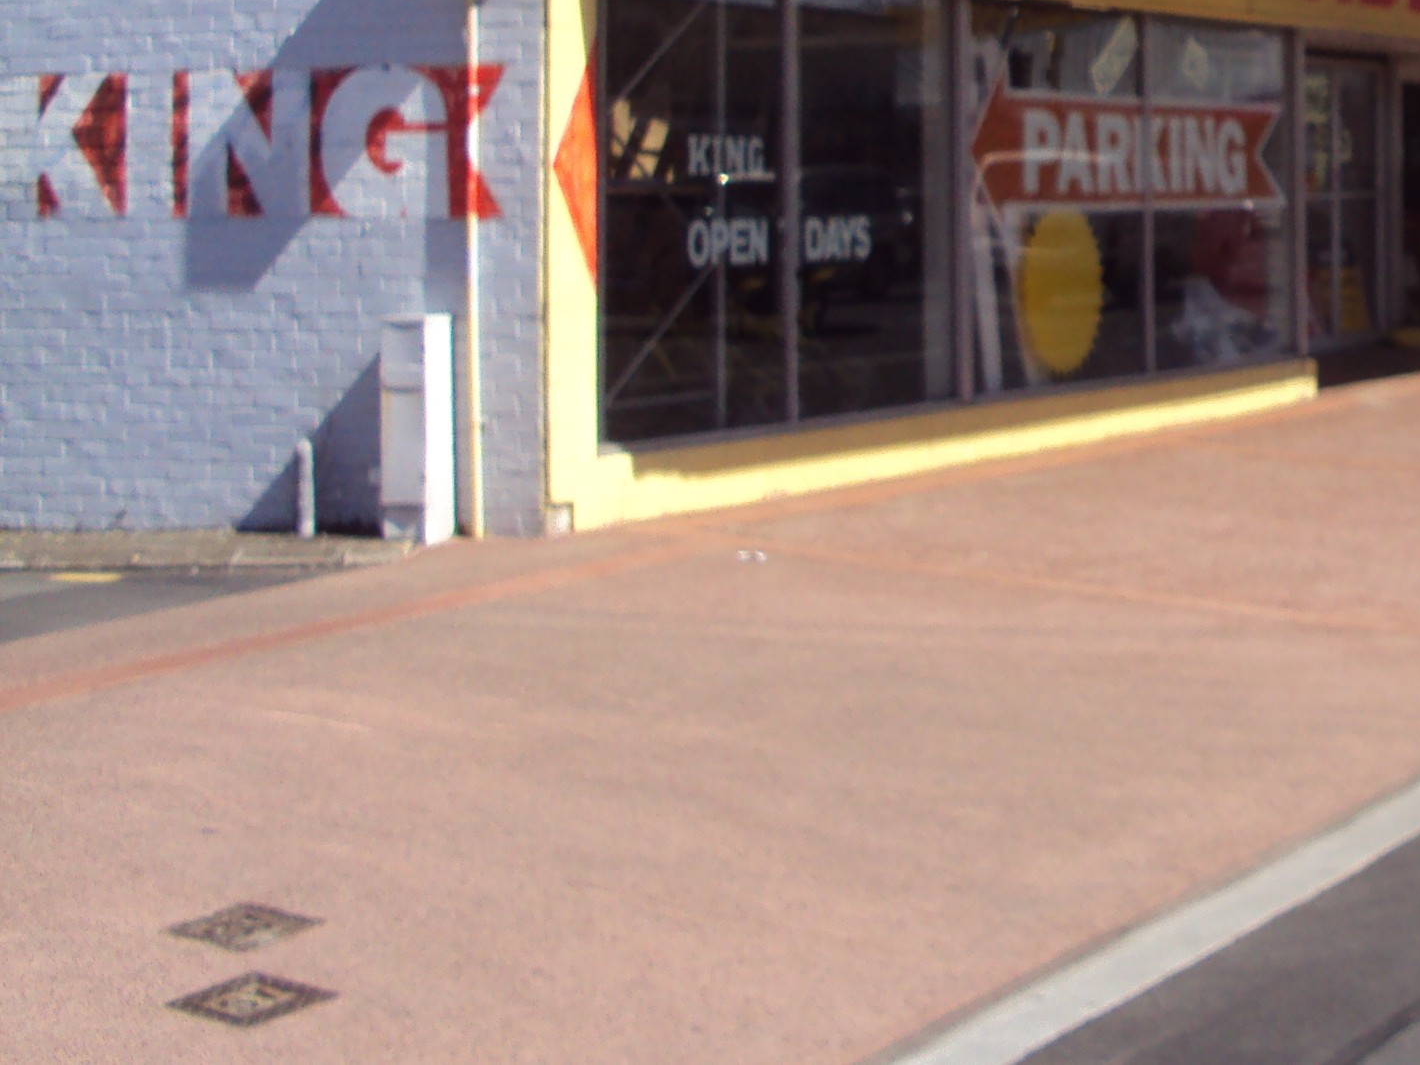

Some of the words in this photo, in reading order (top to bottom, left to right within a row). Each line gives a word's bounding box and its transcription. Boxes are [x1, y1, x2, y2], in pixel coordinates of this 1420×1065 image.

[1021, 108, 1250, 196] PARKING
[687, 218, 770, 267] OPEN
[805, 213, 871, 263] DAYS
